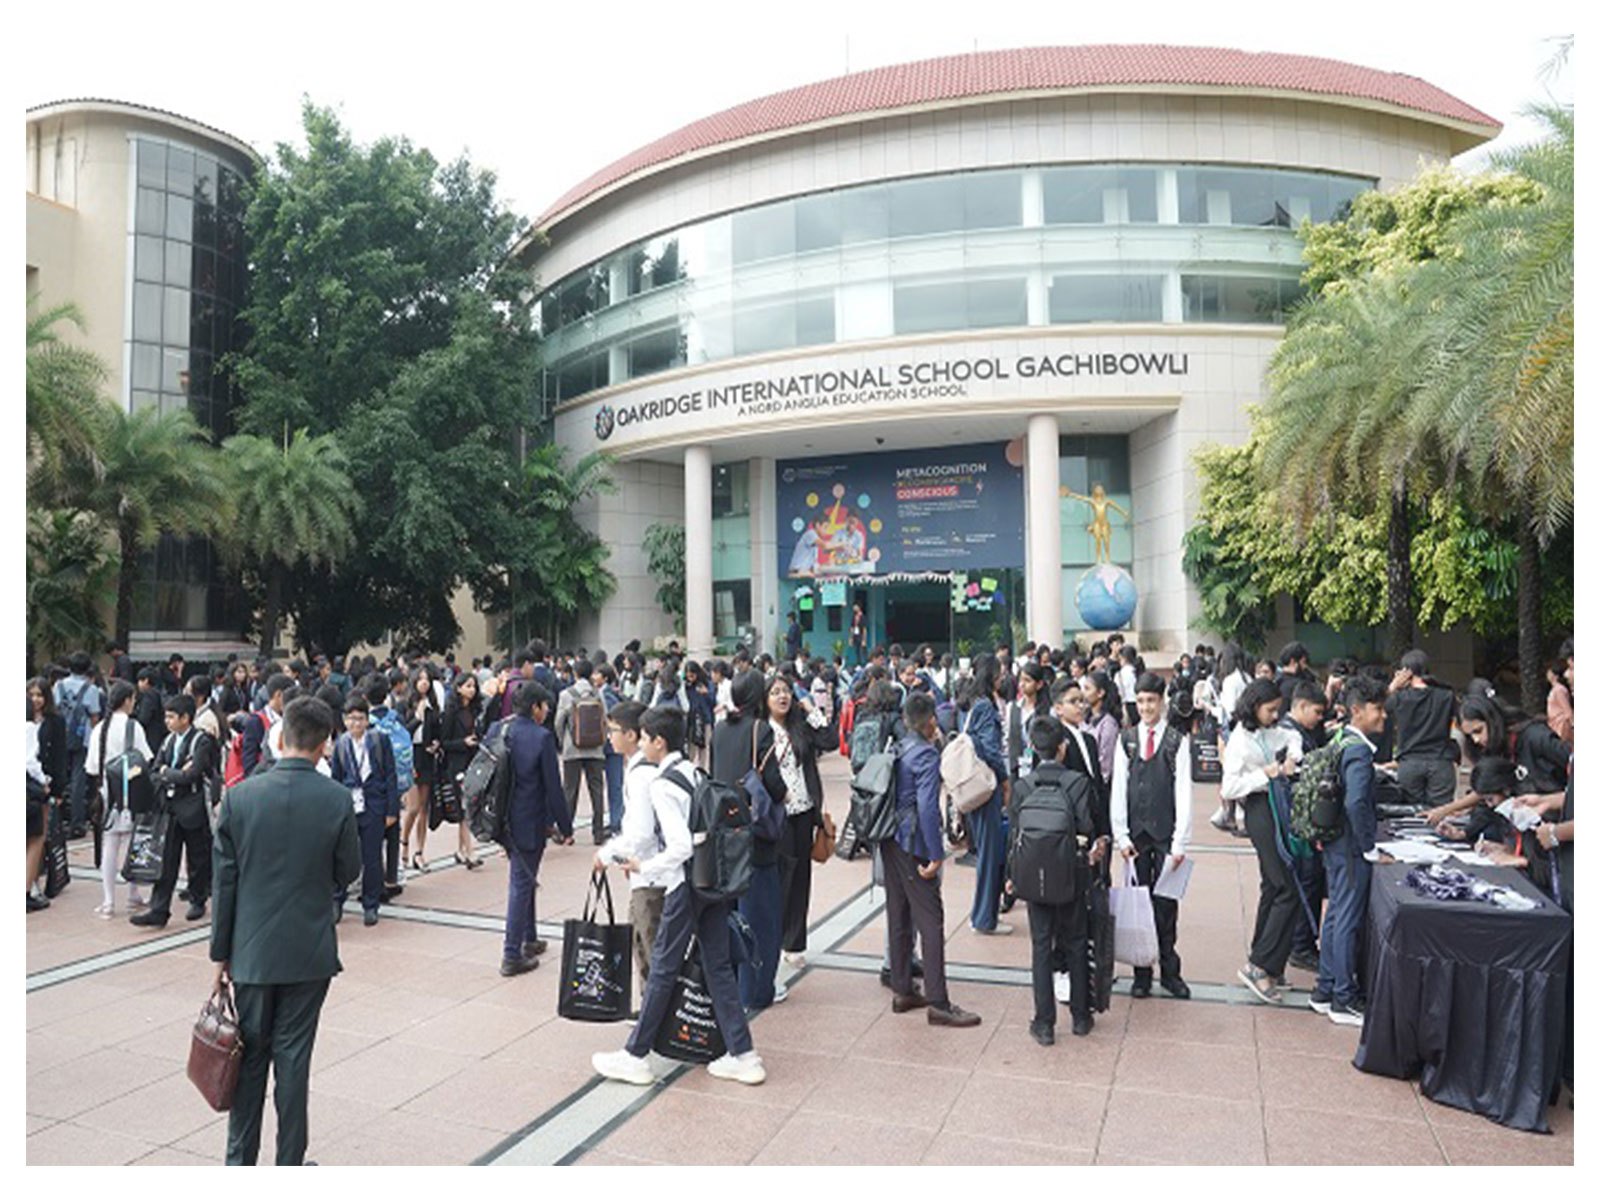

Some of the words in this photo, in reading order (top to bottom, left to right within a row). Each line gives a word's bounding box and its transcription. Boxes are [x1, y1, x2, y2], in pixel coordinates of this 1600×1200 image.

[616, 391, 702, 426] OAKRIDGE
[707, 366, 892, 409] INTERNATIONAL
[898, 358, 1009, 386] SCHOOL
[1016, 353, 1188, 378] GACHIBOWLI
[737, 406, 747, 417] A
[749, 402, 782, 416] NORD
[784, 395, 829, 412] ANGLIA
[832, 387, 907, 407] EDUCATION
[910, 384, 968, 400] SCHOOL
[896, 462, 987, 479] METACOGNITION
[896, 486, 958, 500] CONSCIOUS
